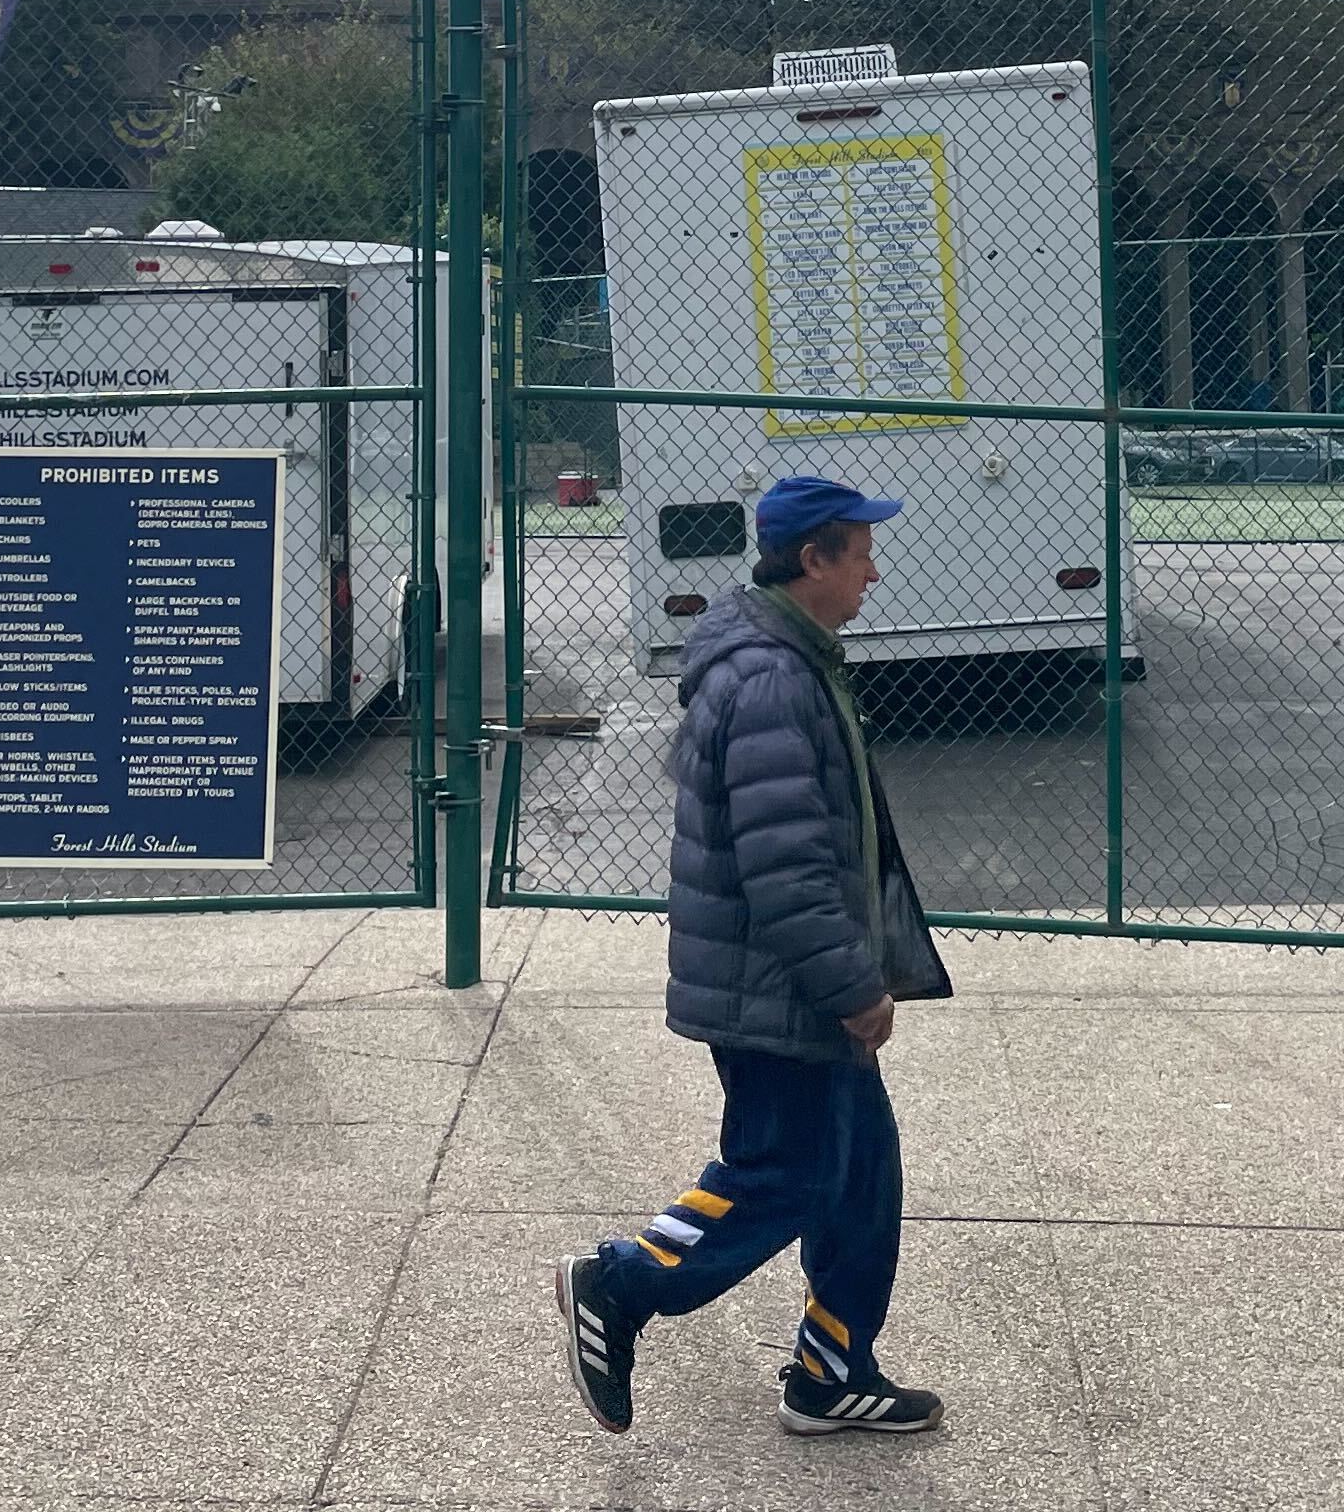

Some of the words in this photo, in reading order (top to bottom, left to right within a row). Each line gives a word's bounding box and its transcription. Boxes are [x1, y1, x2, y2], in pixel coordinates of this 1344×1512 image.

[41, 468, 154, 483] PROHIBITED
[161, 468, 219, 484] ITEMS
[0, 497, 42, 506] COOLERS
[138, 499, 208, 508] PROFESSIONAL
[211, 499, 256, 508] CAMERAS
[138, 520, 169, 528] GOPRO
[170, 520, 213, 528] CAMERAS
[214, 520, 227, 528] OR
[230, 520, 268, 529] DRONES
[137, 539, 161, 548] PETS
[136, 558, 192, 566] INCENDIARY
[196, 558, 236, 567] DEVICES
[136, 577, 196, 586] CAMELBACKS
[36, 593, 63, 602] FOOD
[63, 593, 77, 602] OR
[135, 596, 165, 605] LARGE
[169, 597, 224, 606] BACKPACKS
[227, 597, 241, 606] OR
[135, 607, 170, 616] DUFFEL
[174, 607, 199, 616] BAGS
[44, 623, 64, 631] AND
[134, 626, 165, 634] SPRAY
[53, 634, 83, 642] PROPS
[134, 636, 178, 645] SHARPIES
[179, 637, 186, 646] &
[188, 637, 215, 645] PAINT
[216, 637, 241, 646] PENS
[132, 656, 164, 664] GLASS
[165, 656, 224, 665] CONTAINERS
[132, 666, 145, 675] OF
[148, 667, 166, 675] ANY
[169, 667, 192, 675] KIND
[132, 686, 162, 695] SELFIE
[238, 686, 259, 695] AND
[132, 697, 213, 706] PROJECTILE-TYPE
[217, 697, 257, 706] DEVICES
[22, 702, 36, 711] OR
[40, 702, 70, 711] AUDIO
[43, 713, 95, 722] EQUIPMENT
[130, 716, 168, 725] ILLEGAL
[172, 716, 204, 725] DRUGS
[157, 736, 170, 744] OR
[172, 736, 207, 745] PEPPER
[208, 736, 238, 745] SPRAY
[129, 755, 148, 764] ANY
[152, 755, 183, 764] OTHER
[187, 756, 216, 764] ITEMS
[219, 756, 258, 765] DEEMED
[45, 763, 76, 772] OTHER
[129, 766, 202, 775] INAPPROPRIATE
[206, 767, 218, 775] BY
[222, 767, 254, 776] VENUE
[58, 774, 98, 783] DEVICES
[128, 777, 193, 786] MANAGEMENT
[197, 777, 210, 786] OR
[128, 788, 183, 797] REQUESTED
[187, 788, 199, 797] BY
[203, 788, 235, 797] TOURS
[30, 793, 63, 802] TABLET
[44, 804, 75, 813] 2-WAY
[76, 805, 110, 814] RADIOS
[51, 834, 93, 851] Forest
[96, 833, 136, 852] Hills
[139, 835, 197, 853] Stadium
